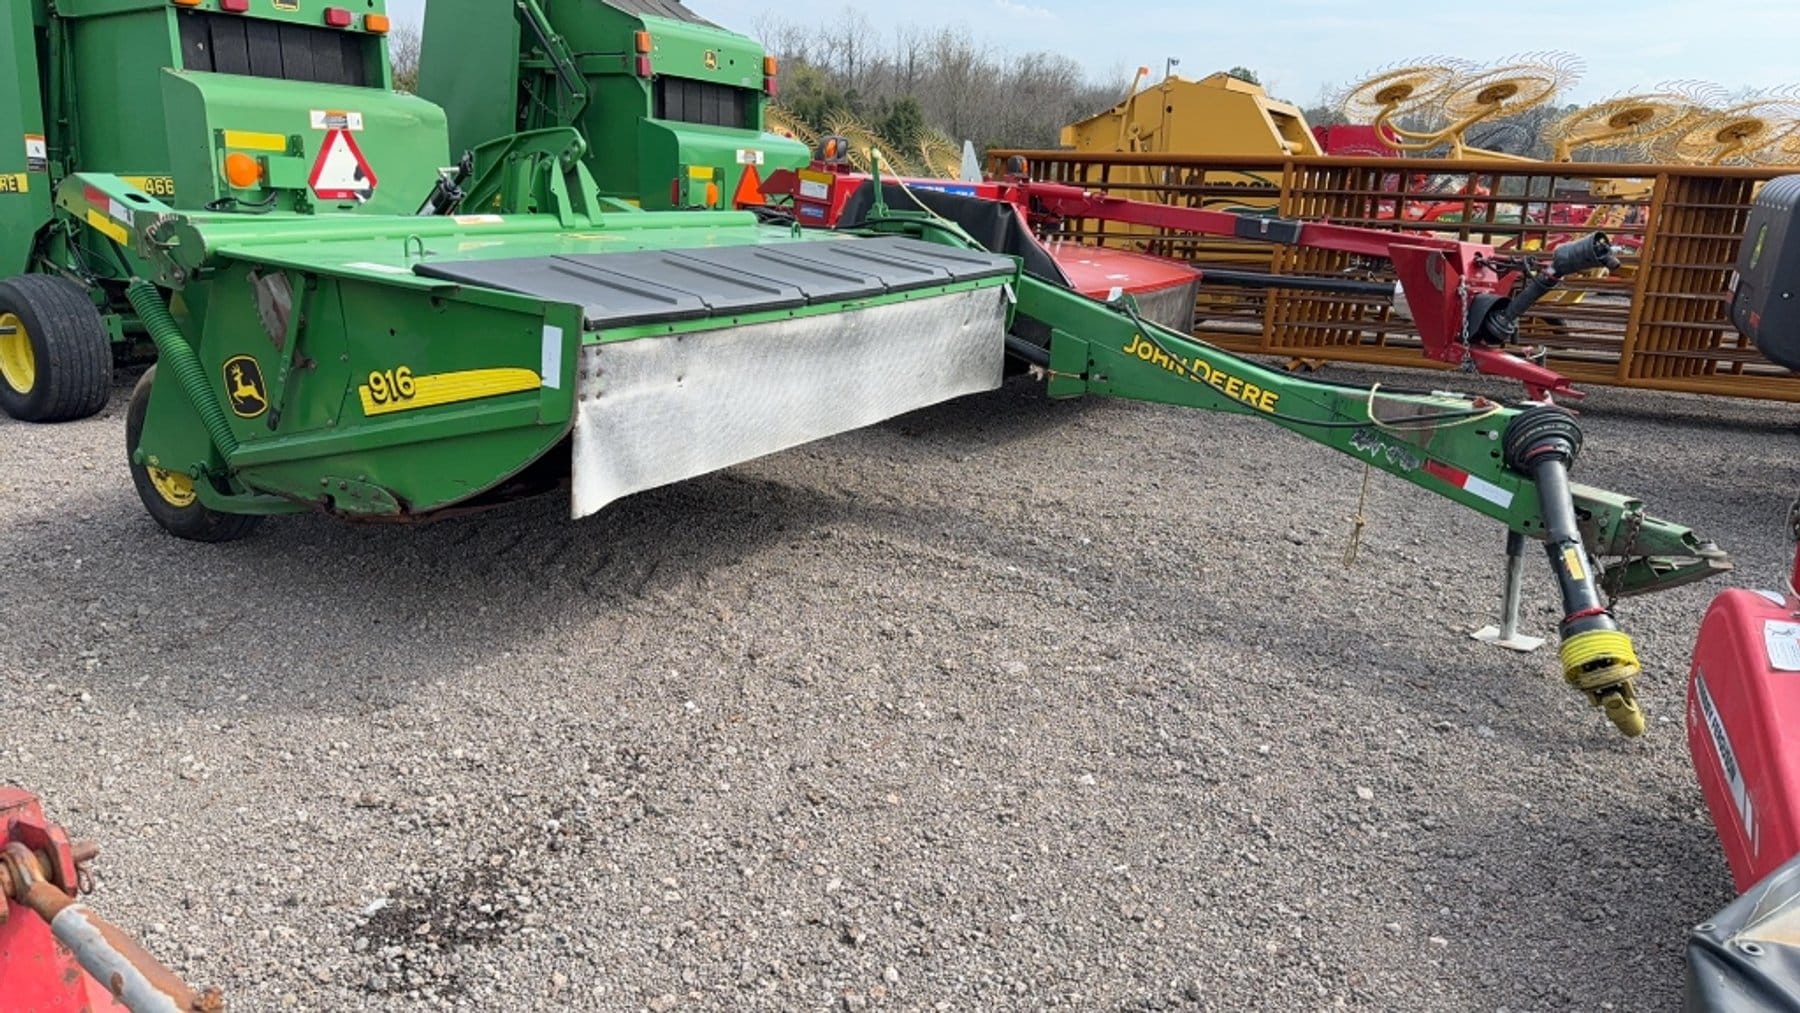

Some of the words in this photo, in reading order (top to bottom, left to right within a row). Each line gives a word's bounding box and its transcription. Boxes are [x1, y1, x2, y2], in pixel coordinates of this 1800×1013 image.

[145, 178, 175, 195] 466
[369, 365, 416, 404] 916
[1123, 334, 1189, 376] JOHN
[1190, 358, 1280, 413] DEERE
